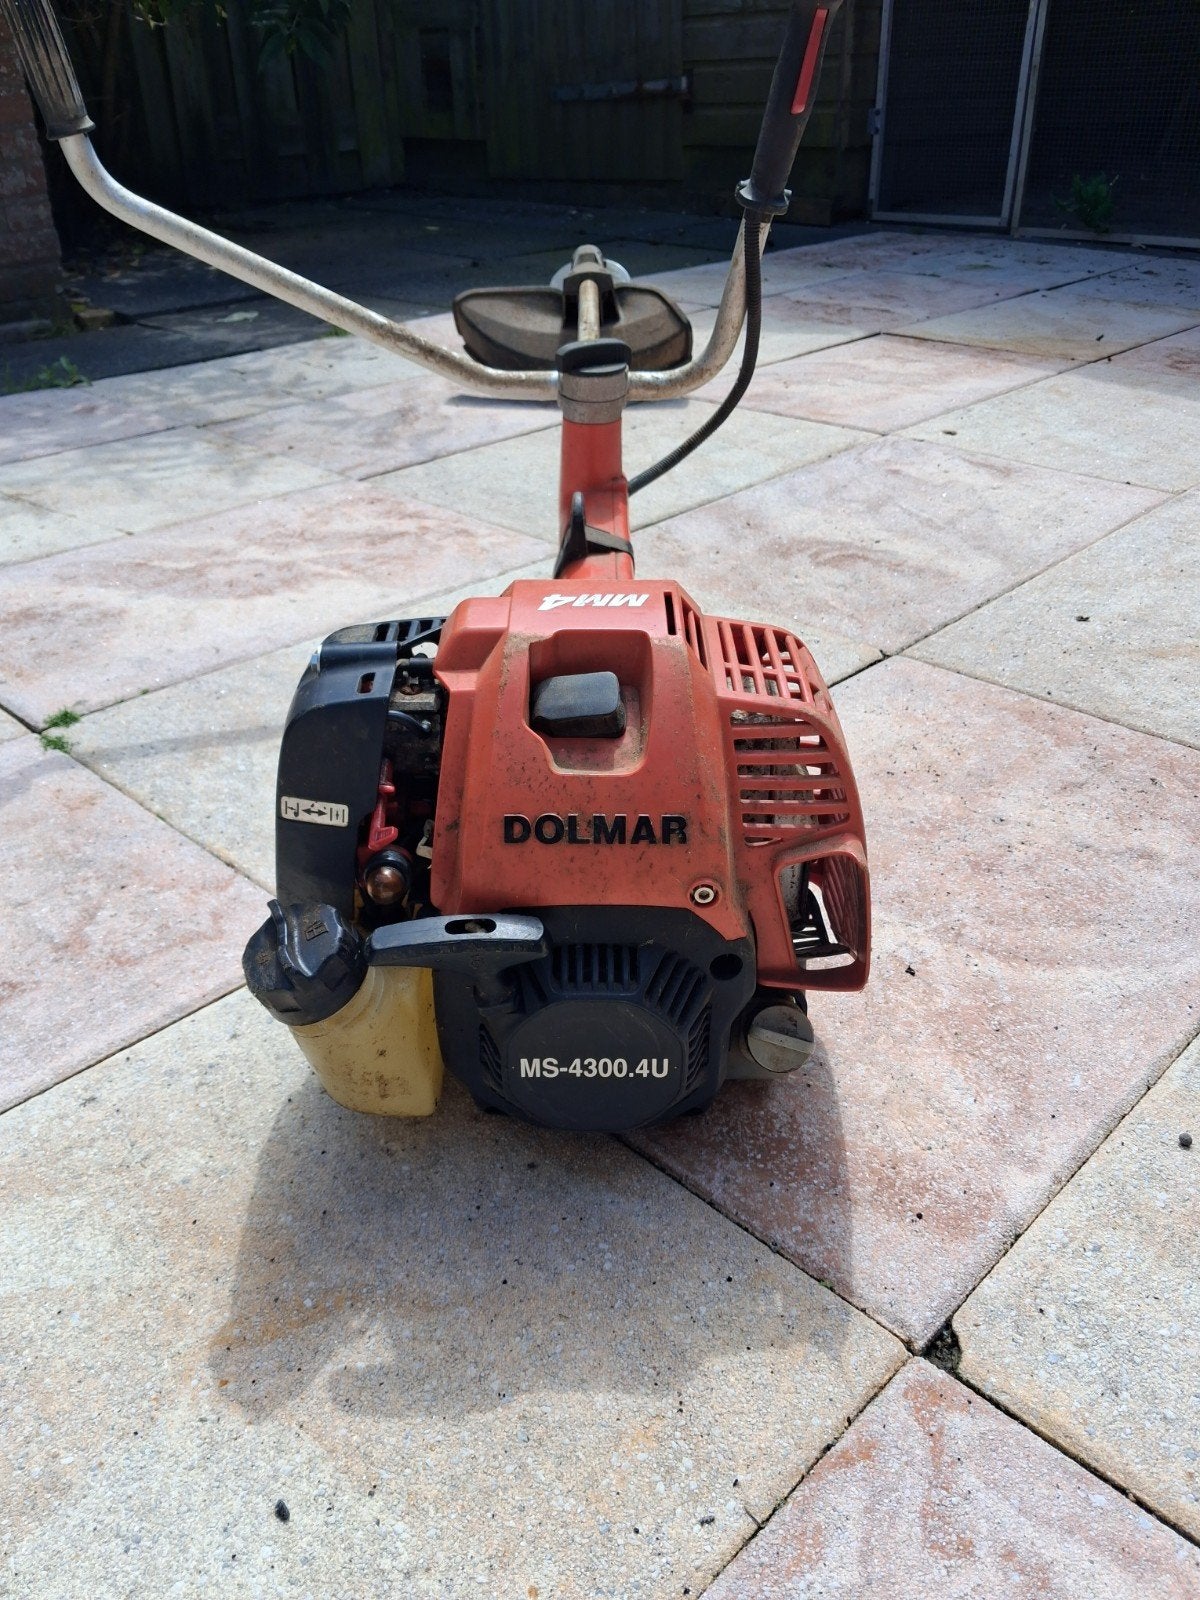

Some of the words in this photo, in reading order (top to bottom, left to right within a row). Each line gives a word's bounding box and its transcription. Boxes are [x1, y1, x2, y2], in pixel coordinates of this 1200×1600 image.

[537, 593, 650, 611] MM4
[503, 812, 688, 845] DOLMAR
[519, 1057, 670, 1079] MS-4300.4U
